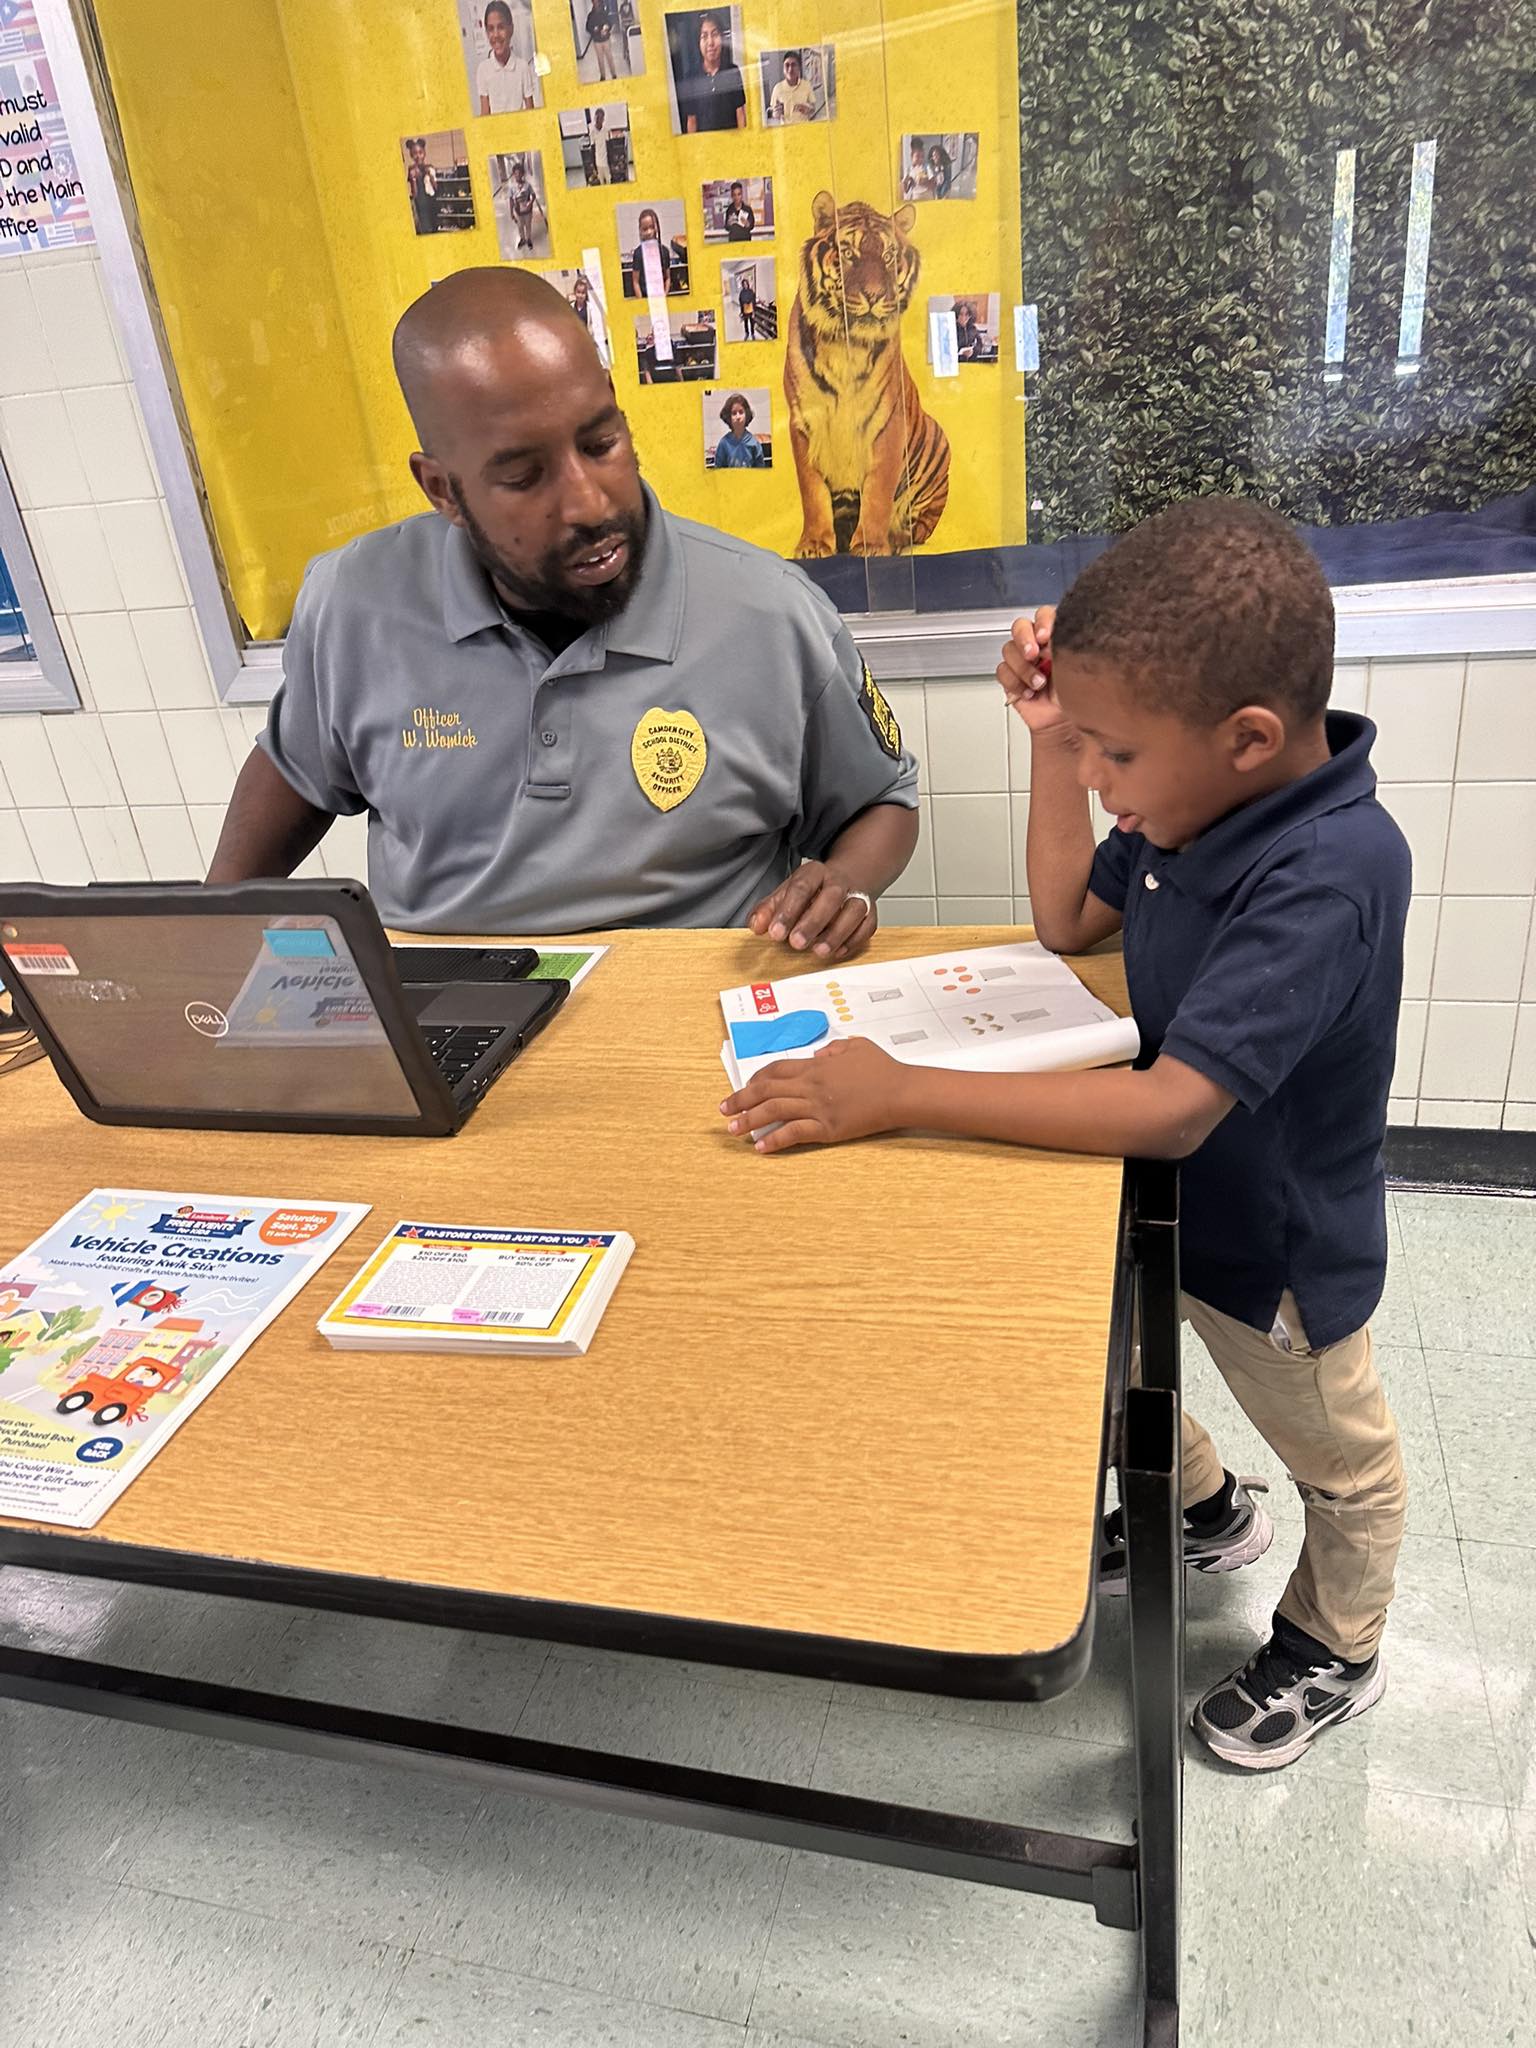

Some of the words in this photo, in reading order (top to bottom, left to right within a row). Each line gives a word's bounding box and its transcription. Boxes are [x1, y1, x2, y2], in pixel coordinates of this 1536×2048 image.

[0, 89, 47, 116] must
[0, 119, 42, 147] valid
[17, 149, 53, 175] and
[6, 185, 38, 207] the
[40, 180, 85, 202] Main
[0, 217, 38, 238] ffice
[413, 707, 462, 729] Officer
[402, 729, 423, 748] W.
[648, 725, 677, 735] CAMDEN
[679, 727, 694, 739] CITY
[642, 736, 667, 749] SCHOOL
[669, 736, 698, 754] DISTRICT
[651, 771, 685, 785] SECURITY
[653, 783, 682, 794] OFFICER
[190, 1014, 225, 1025] DELL
[165, 1218, 194, 1228] FREE
[194, 1220, 237, 1231] EVENTS
[276, 1212, 329, 1224] Saturday,
[270, 1221, 299, 1231] Sept.
[301, 1223, 319, 1232] 20
[424, 1229, 471, 1240] IN-STORE
[472, 1232, 512, 1242] OFFERS
[511, 1234, 537, 1243] JUST
[537, 1236, 560, 1244] FOR
[561, 1237, 584, 1245] YOU
[69, 1234, 158, 1255] Vehicle
[161, 1243, 284, 1266] Creations
[96, 1253, 155, 1267] featuring
[155, 1259, 188, 1269] Kwik
[121, 1264, 143, 1273] crafts
[151, 1269, 181, 1278] explore
[181, 1271, 219, 1280] hands-on
[219, 1274, 260, 1283] activities!
[14, 1421, 35, 1429] ONLY
[20, 1429, 51, 1441] Board
[50, 1433, 76, 1443] Book
[2, 1437, 50, 1450] Purchase!
[82, 1449, 111, 1459] BACK
[15, 1462, 45, 1472] Could
[45, 1465, 65, 1475] Win
[33, 1474, 64, 1485] E-Gift
